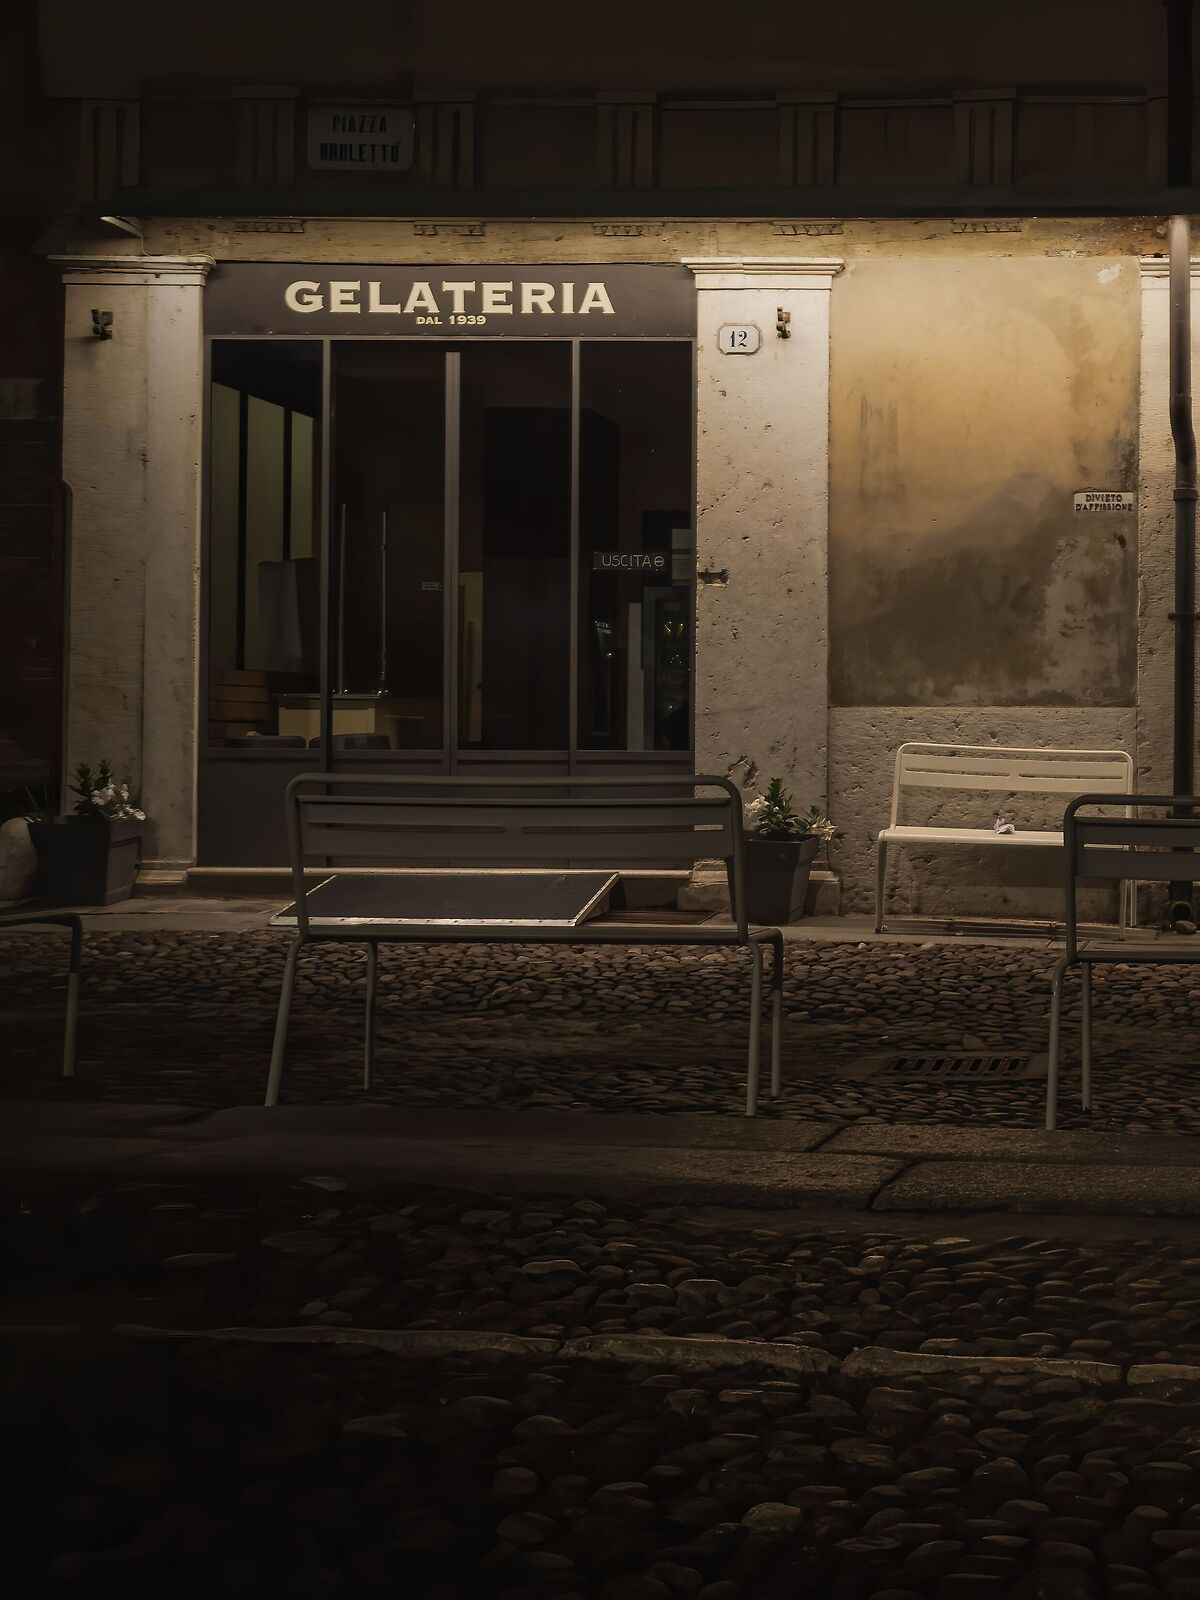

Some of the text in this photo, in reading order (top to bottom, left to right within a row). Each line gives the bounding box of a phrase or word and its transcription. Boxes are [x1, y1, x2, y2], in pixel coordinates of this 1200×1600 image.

[332, 115, 387, 133] PIAZZA
[285, 280, 616, 315] GELATERIA
[416, 315, 487, 325] DAL 1939
[730, 330, 748, 348] 12
[1085, 494, 1123, 502] DIVIETO
[1075, 503, 1133, 511] D'AFFISSIONE
[601, 554, 652, 567] USCITA
